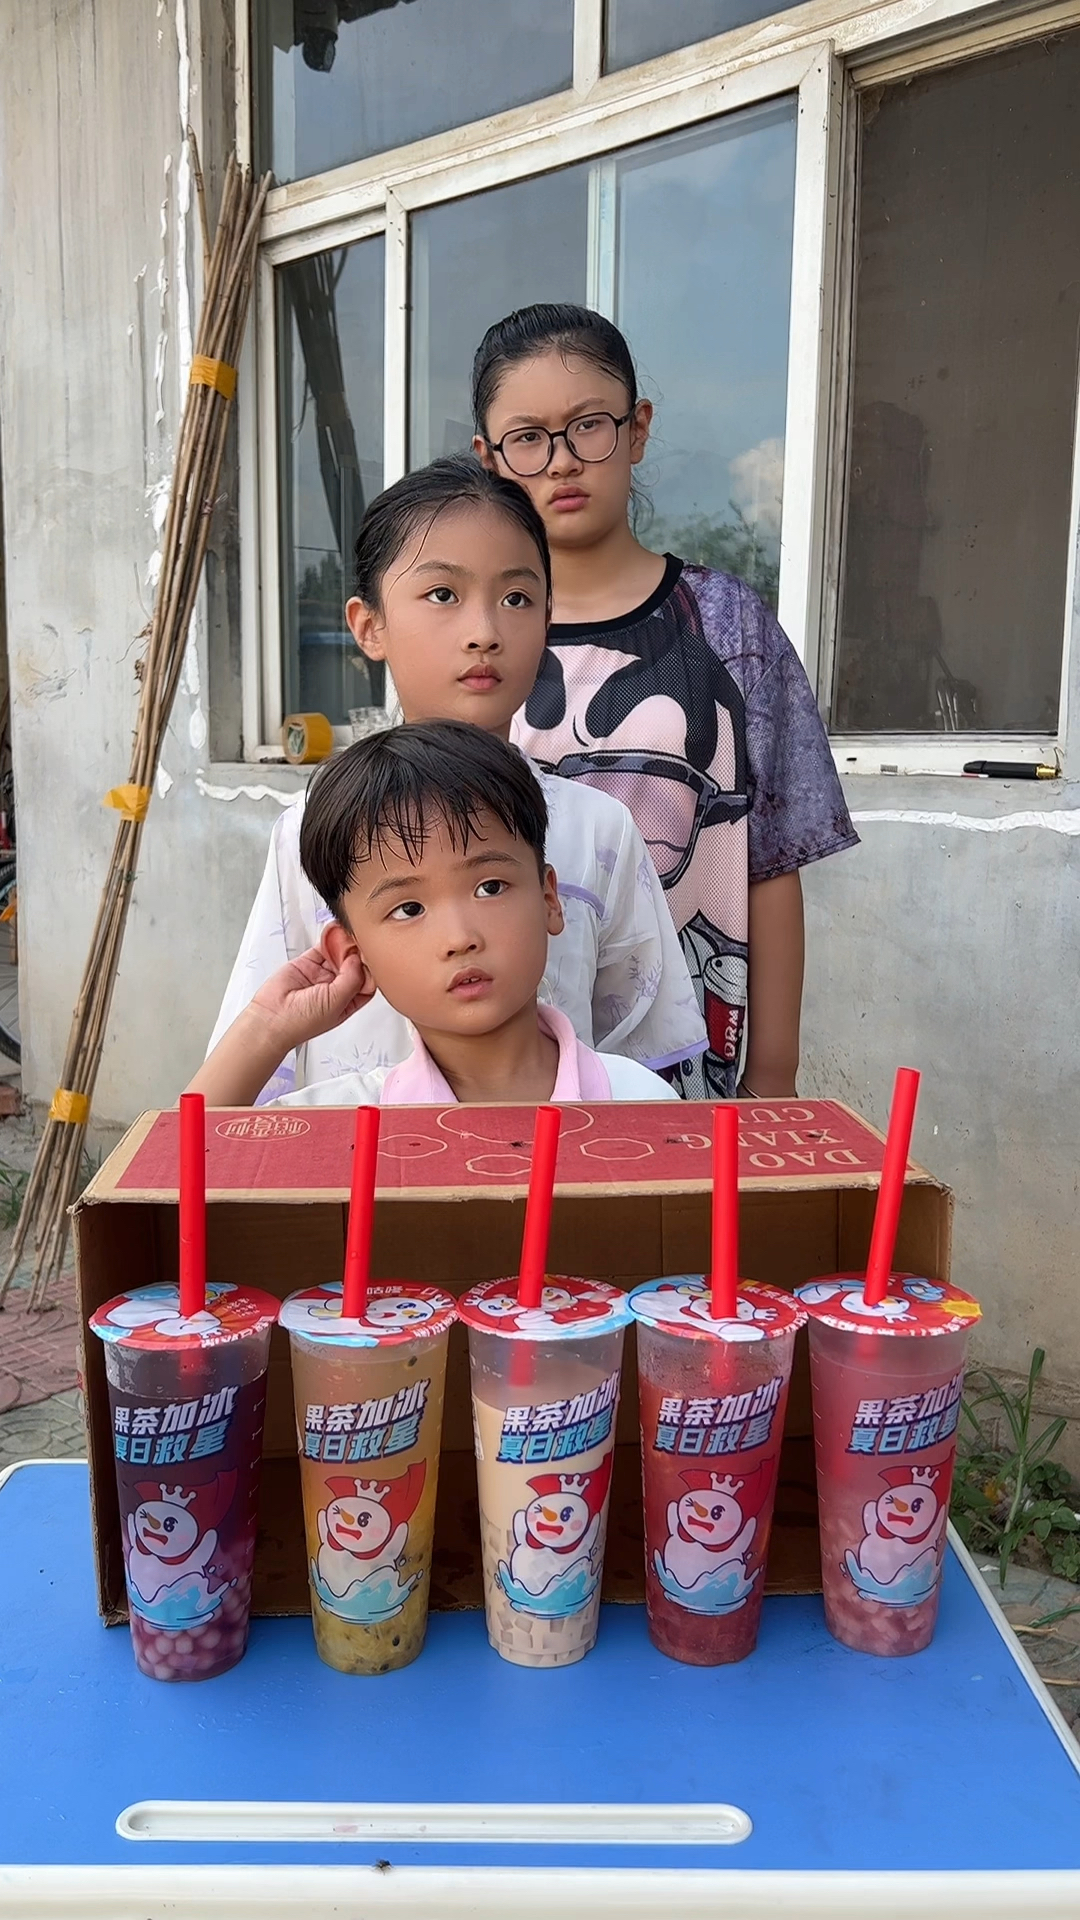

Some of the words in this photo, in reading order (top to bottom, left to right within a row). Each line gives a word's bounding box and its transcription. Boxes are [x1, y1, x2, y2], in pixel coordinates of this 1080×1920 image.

[749, 1148, 867, 1168] DAO
[113, 1385, 240, 1435] 果茶加冰
[304, 1378, 431, 1433] 果茶加冰
[503, 1371, 620, 1432] 果茶加冰
[658, 1376, 783, 1427] 果茶加冰
[112, 1417, 232, 1464] 夏日救星
[303, 1414, 423, 1464] 夏日救星
[496, 1408, 614, 1464] 夏日救星
[653, 1413, 774, 1456] 夏日救星
